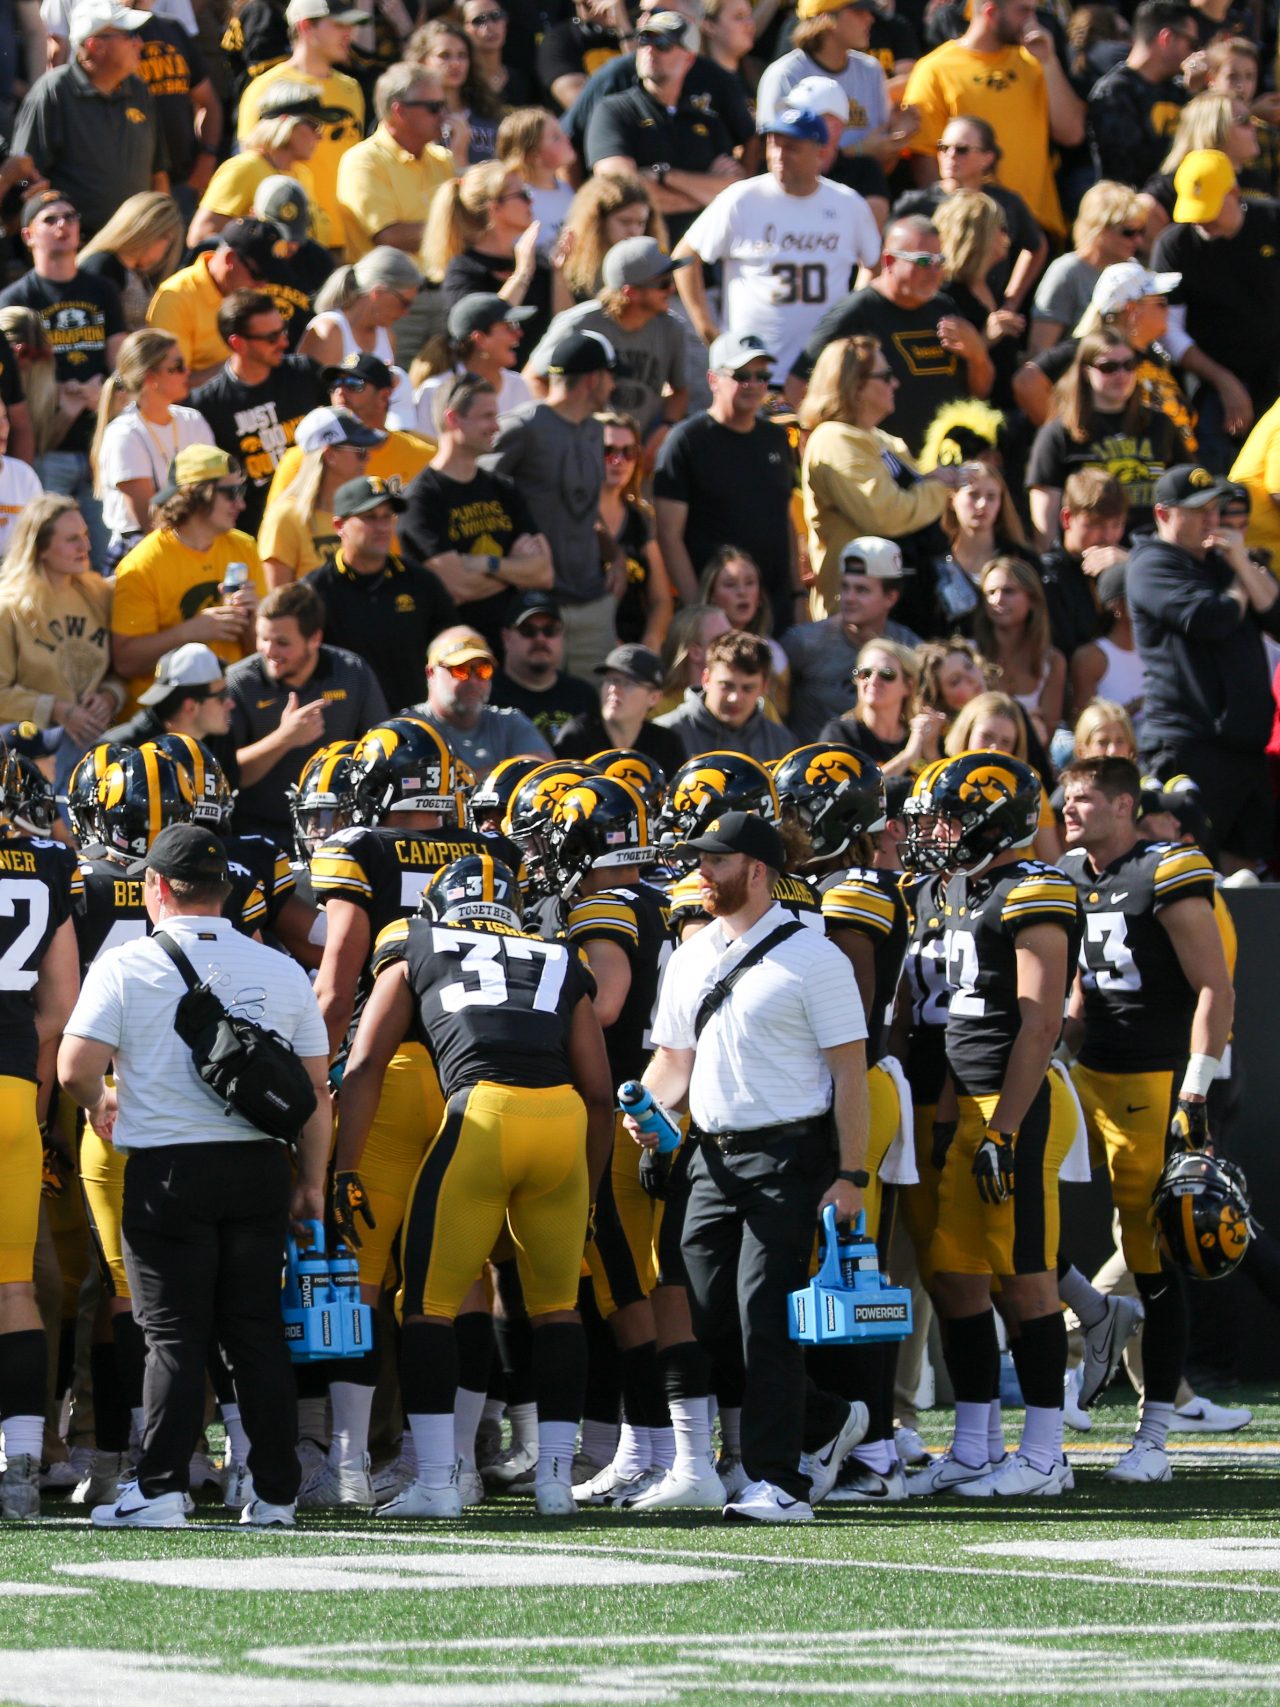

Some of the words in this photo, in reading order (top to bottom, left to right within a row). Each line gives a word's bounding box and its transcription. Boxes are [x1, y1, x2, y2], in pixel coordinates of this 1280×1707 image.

[138, 53, 189, 83] OWA
[764, 223, 840, 251] Iowa
[772, 263, 827, 304] 30
[234, 401, 279, 436] JUST
[35, 614, 107, 652] IOWA
[205, 773, 216, 796] 5
[464, 876, 509, 899] 37
[846, 867, 879, 883] 11
[458, 904, 512, 922] TOGETHER
[1078, 911, 1143, 991] 3
[431, 926, 569, 1015] 37
[856, 1305, 906, 1320] POWERADE
